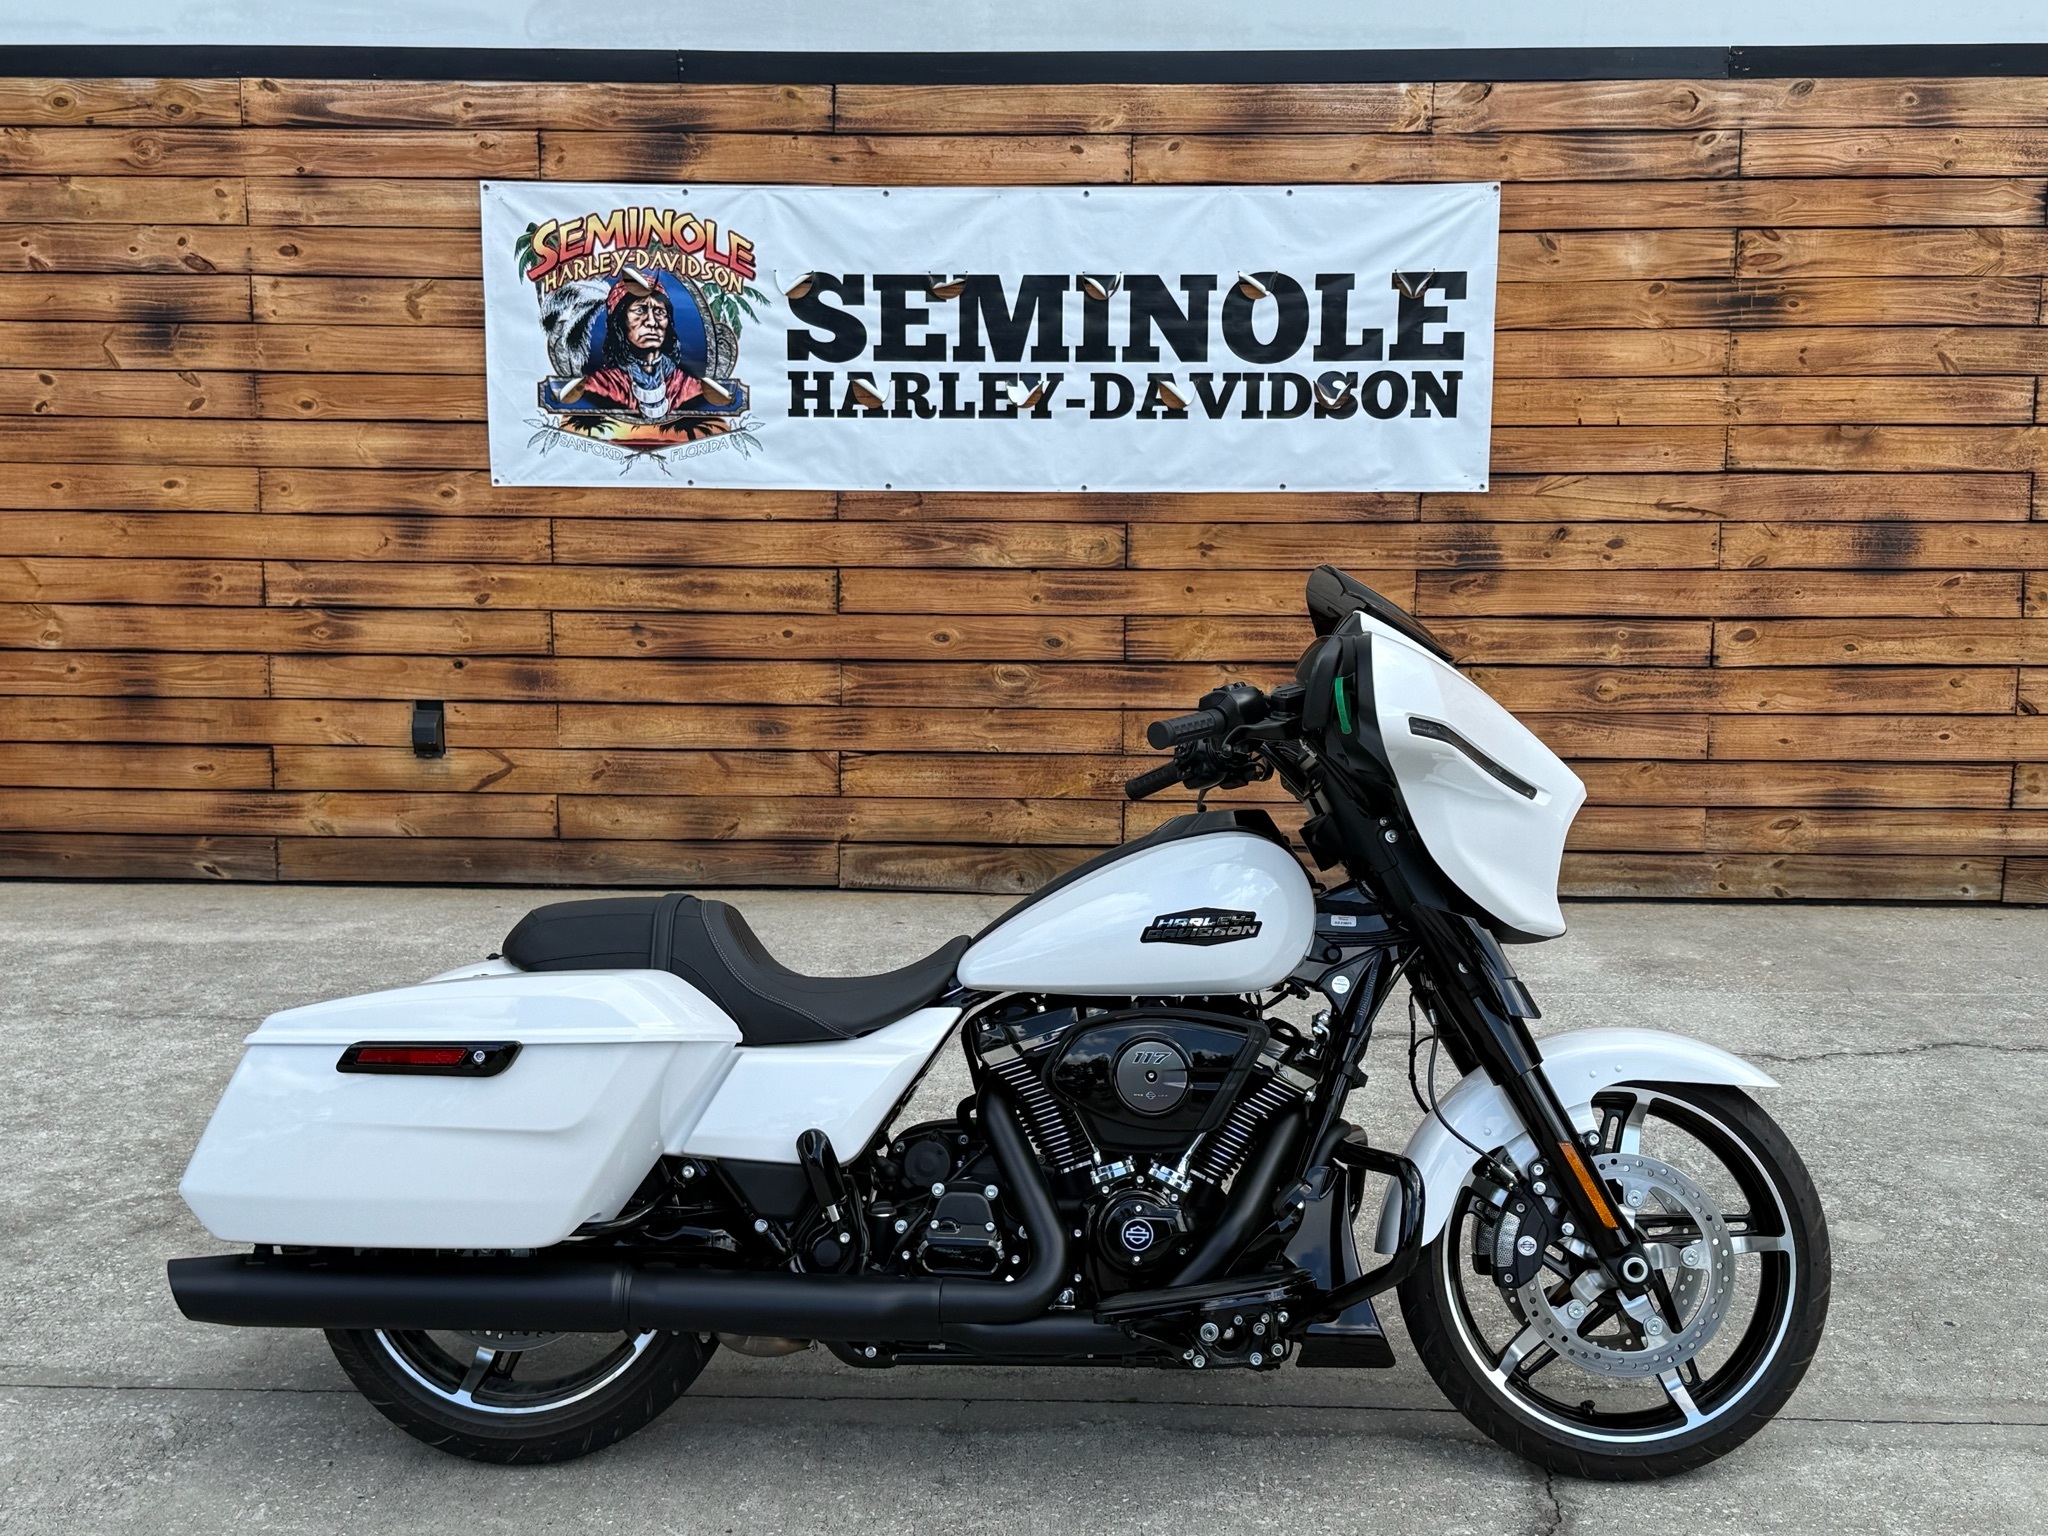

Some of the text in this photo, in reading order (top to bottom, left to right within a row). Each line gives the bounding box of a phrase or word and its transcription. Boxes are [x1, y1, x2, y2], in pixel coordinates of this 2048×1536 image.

[527, 207, 756, 281] SEMINOLE
[543, 249, 744, 294] HARLEY-DAVIDSON
[786, 271, 1467, 364] SEMINOLE
[787, 371, 1463, 420] HARLEY-DAVIDSON
[559, 436, 729, 464] SANFORD, FLORIDA
[1145, 925, 1257, 939] DAVIDSON
[1157, 915, 1252, 928] HARLEY-
[1132, 1051, 1172, 1064] 117
